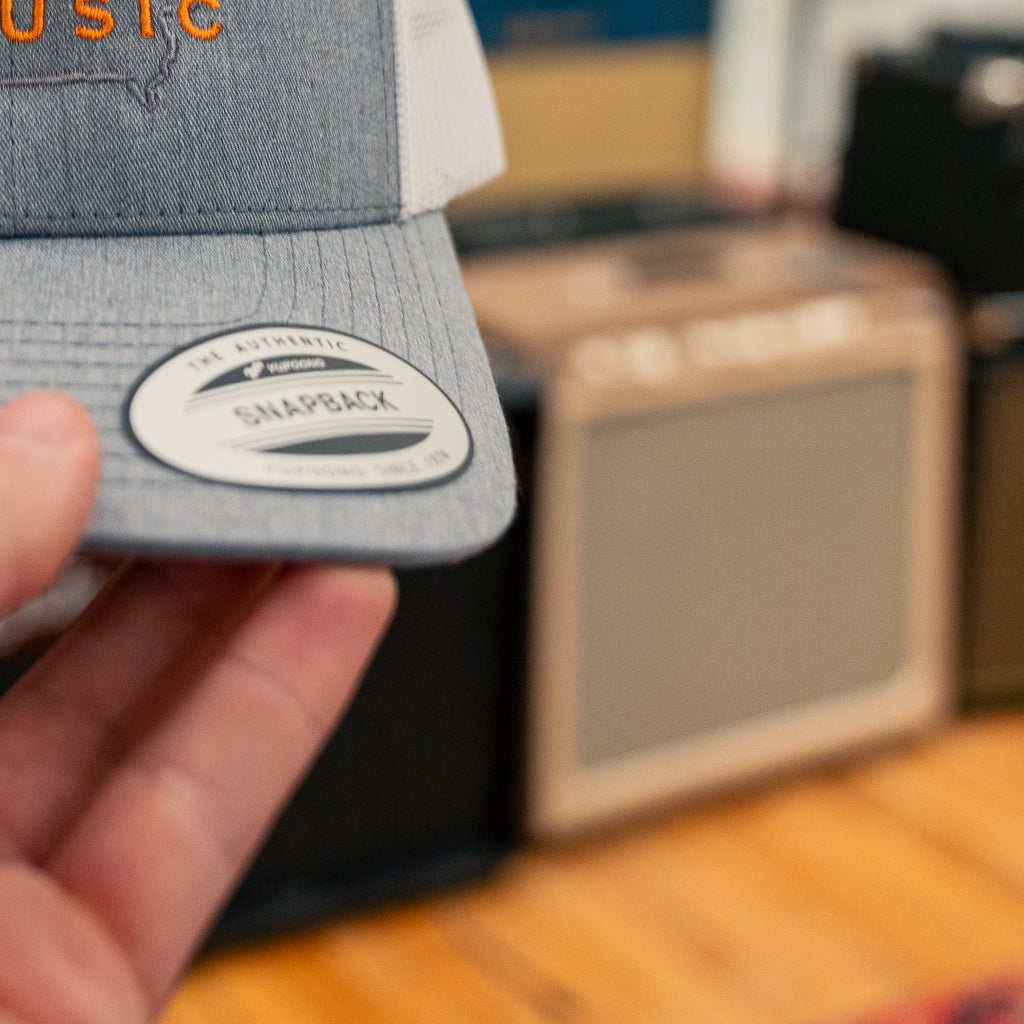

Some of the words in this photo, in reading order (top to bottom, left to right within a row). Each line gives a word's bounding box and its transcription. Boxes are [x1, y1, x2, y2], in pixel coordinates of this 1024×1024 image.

[187, 350, 224, 372] THE
[234, 334, 349, 354] AUTHENTIC
[232, 389, 400, 426] SNAPBACK
